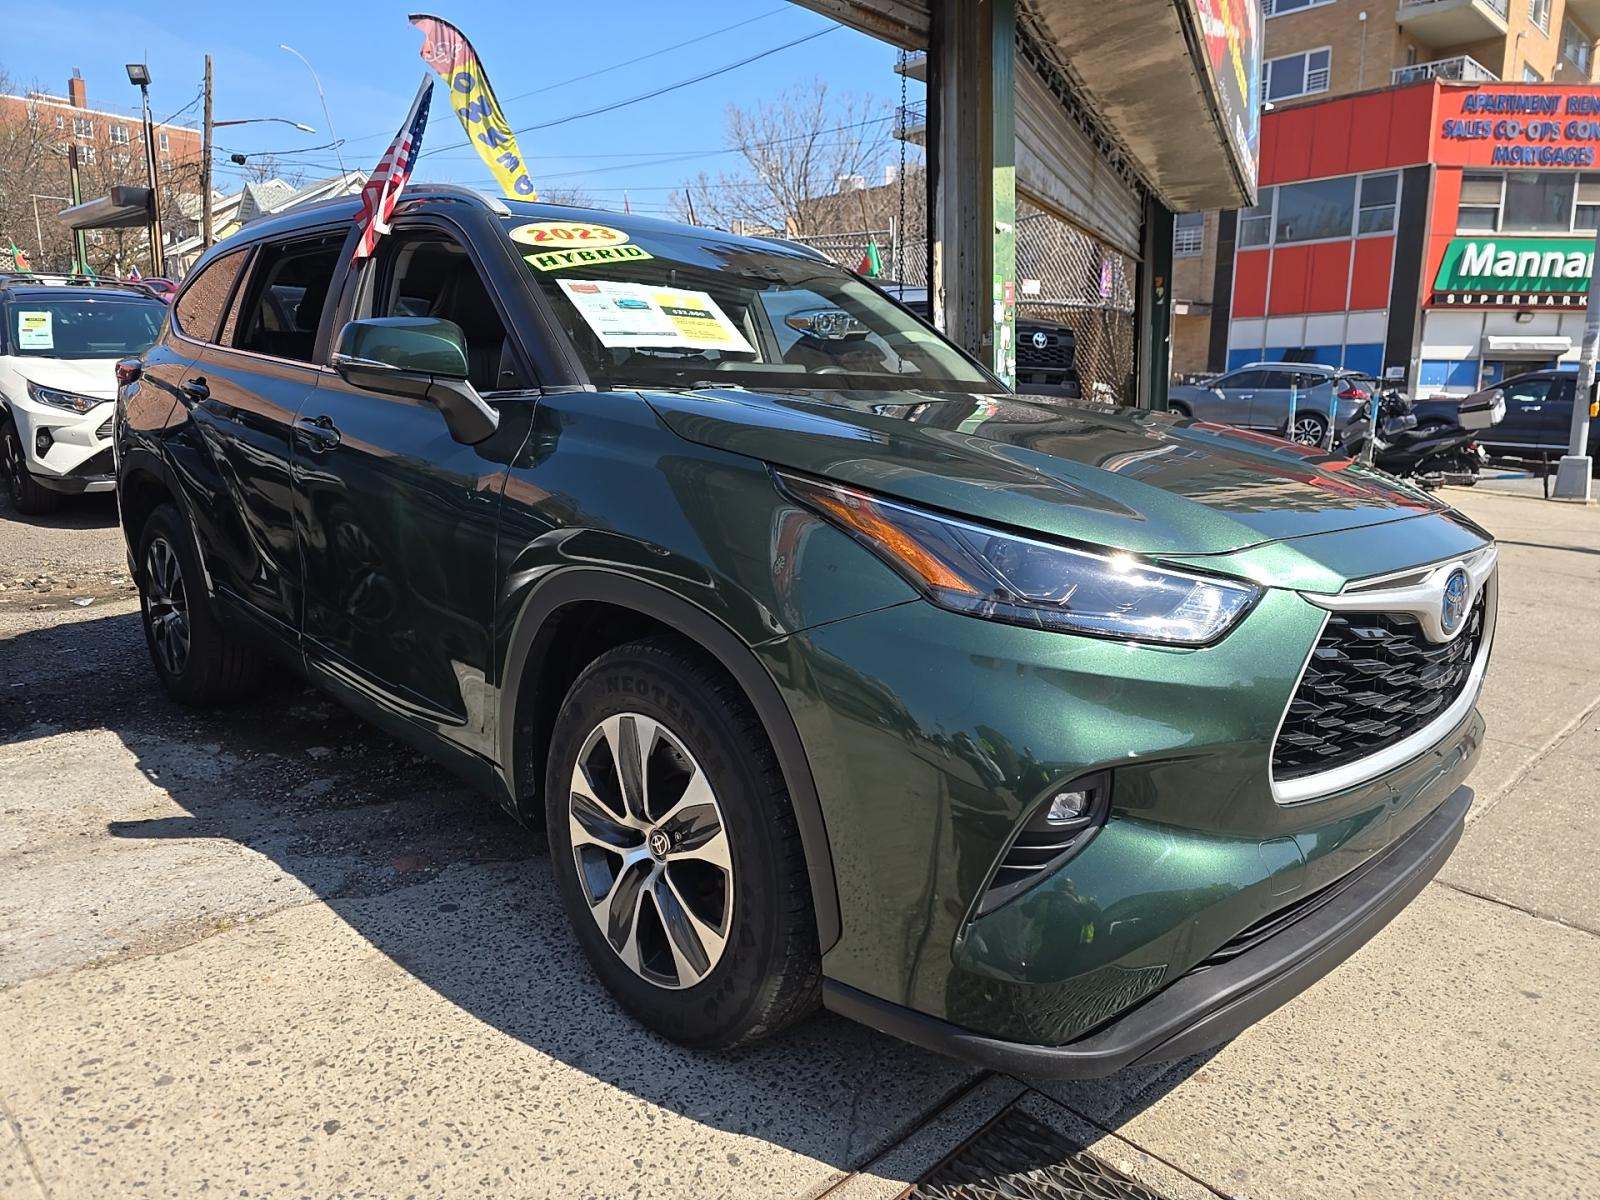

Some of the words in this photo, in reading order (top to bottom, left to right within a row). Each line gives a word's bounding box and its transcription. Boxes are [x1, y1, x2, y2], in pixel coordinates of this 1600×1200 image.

[1464, 95, 1561, 113] APARTMENT
[1443, 120, 1491, 139] SALES
[1494, 120, 1560, 140] CO-OPS
[1493, 146, 1594, 164] MORTGAGES
[526, 224, 617, 242] 2023
[536, 246, 643, 268] HYBRID
[1446, 294, 1588, 306] SUPERMARK
